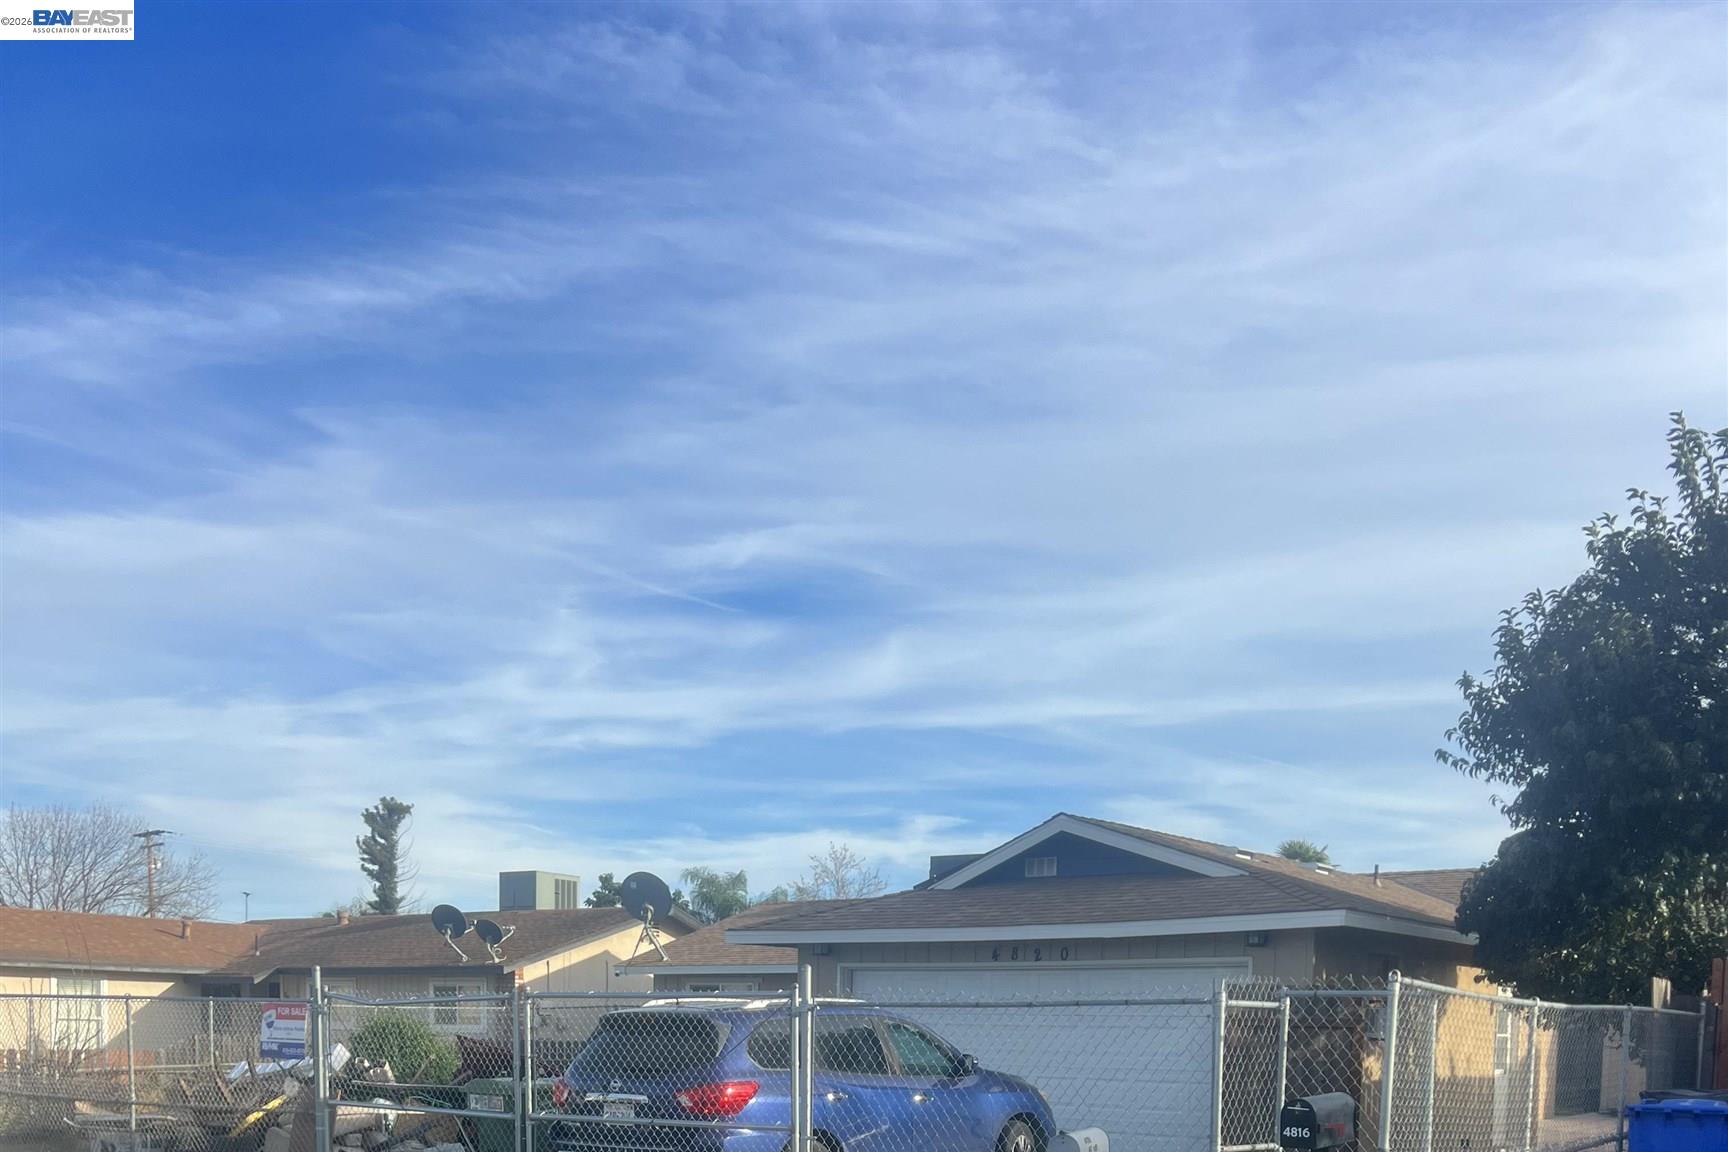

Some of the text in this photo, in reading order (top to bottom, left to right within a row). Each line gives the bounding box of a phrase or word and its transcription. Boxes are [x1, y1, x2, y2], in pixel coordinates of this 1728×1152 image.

[991, 945, 1069, 962] 4820
[277, 1007, 307, 1016] FOR SALE
[1283, 1127, 1310, 1138] 4816
